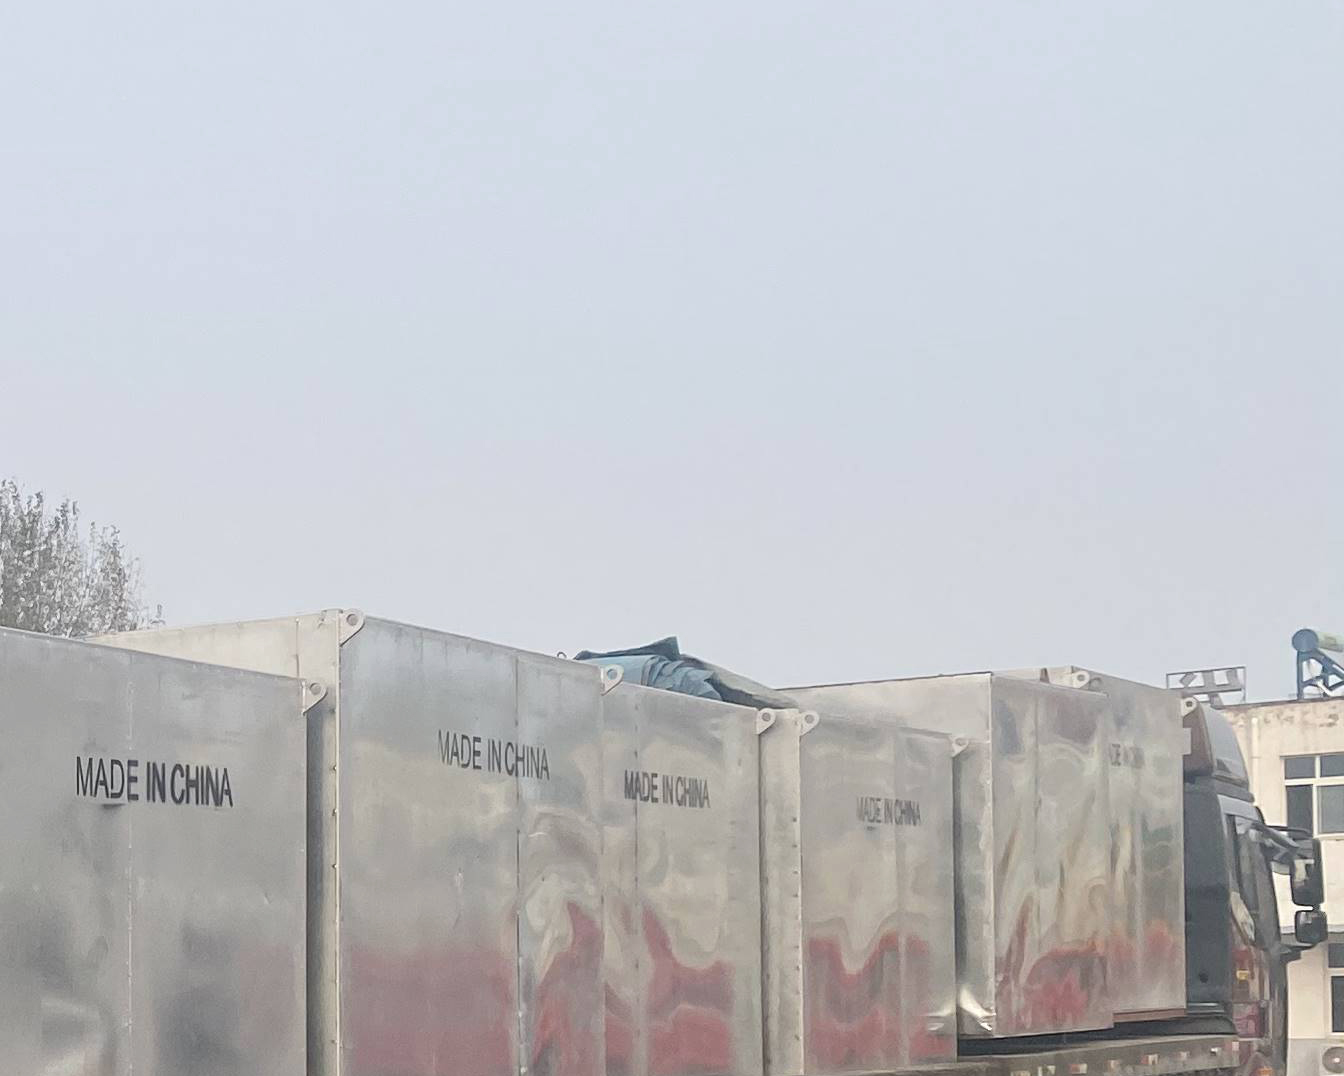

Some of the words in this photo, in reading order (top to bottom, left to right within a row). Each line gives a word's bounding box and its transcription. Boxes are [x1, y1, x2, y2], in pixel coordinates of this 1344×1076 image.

[438, 729, 482, 770] MADE
[487, 738, 502, 774] IN
[504, 741, 550, 780] CHINA
[76, 756, 139, 801] MADE
[146, 761, 166, 803] IN
[170, 763, 234, 808] CHINA
[623, 769, 658, 803] MADE
[662, 774, 674, 805] IN
[675, 775, 711, 808] CHINA
